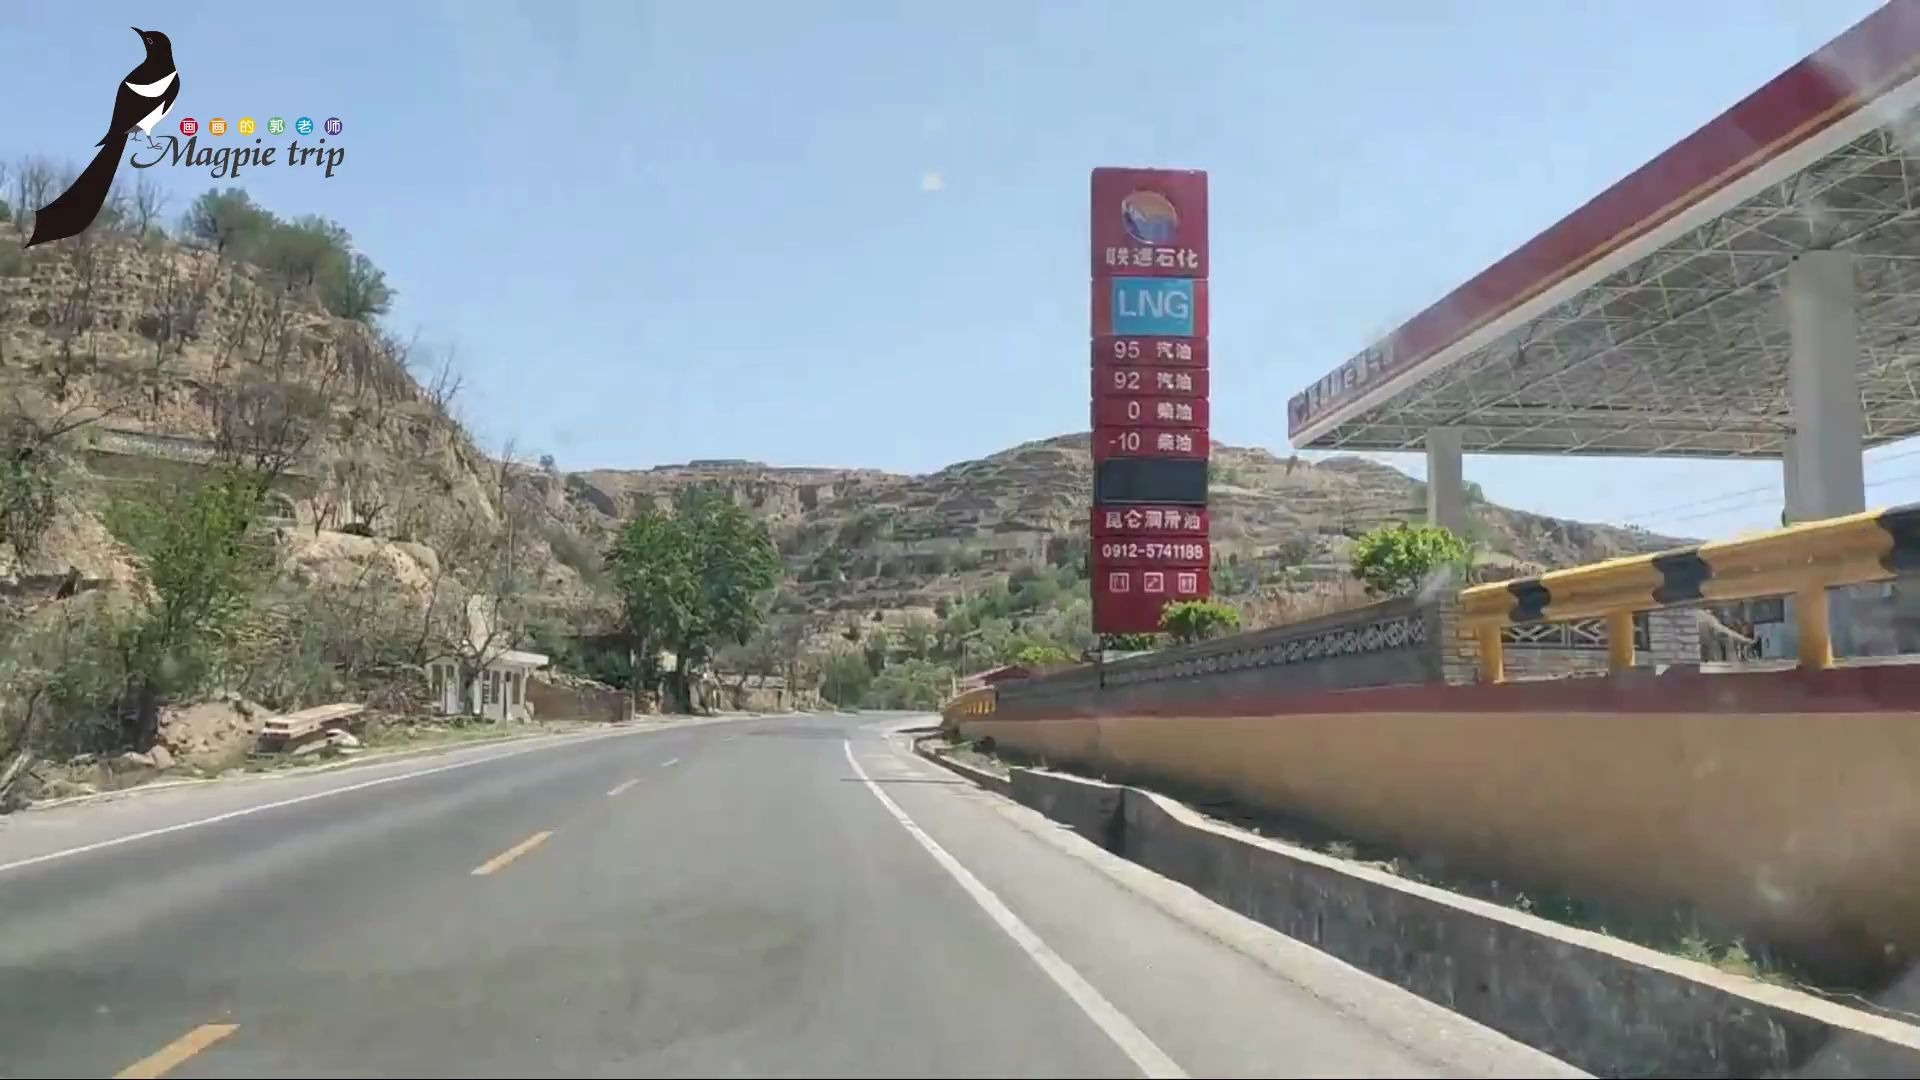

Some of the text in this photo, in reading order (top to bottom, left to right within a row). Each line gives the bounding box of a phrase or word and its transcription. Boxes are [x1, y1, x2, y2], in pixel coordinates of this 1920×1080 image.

[1118, 290, 1188, 319] LNG
[1113, 341, 1192, 360] 95 汽油
[1113, 371, 1192, 391] 92 汽油
[1127, 401, 1141, 419] 0
[1109, 432, 1140, 451] -10
[1105, 509, 1200, 530] 昆仑润滑油
[1102, 543, 1203, 560] 0912-5741188
